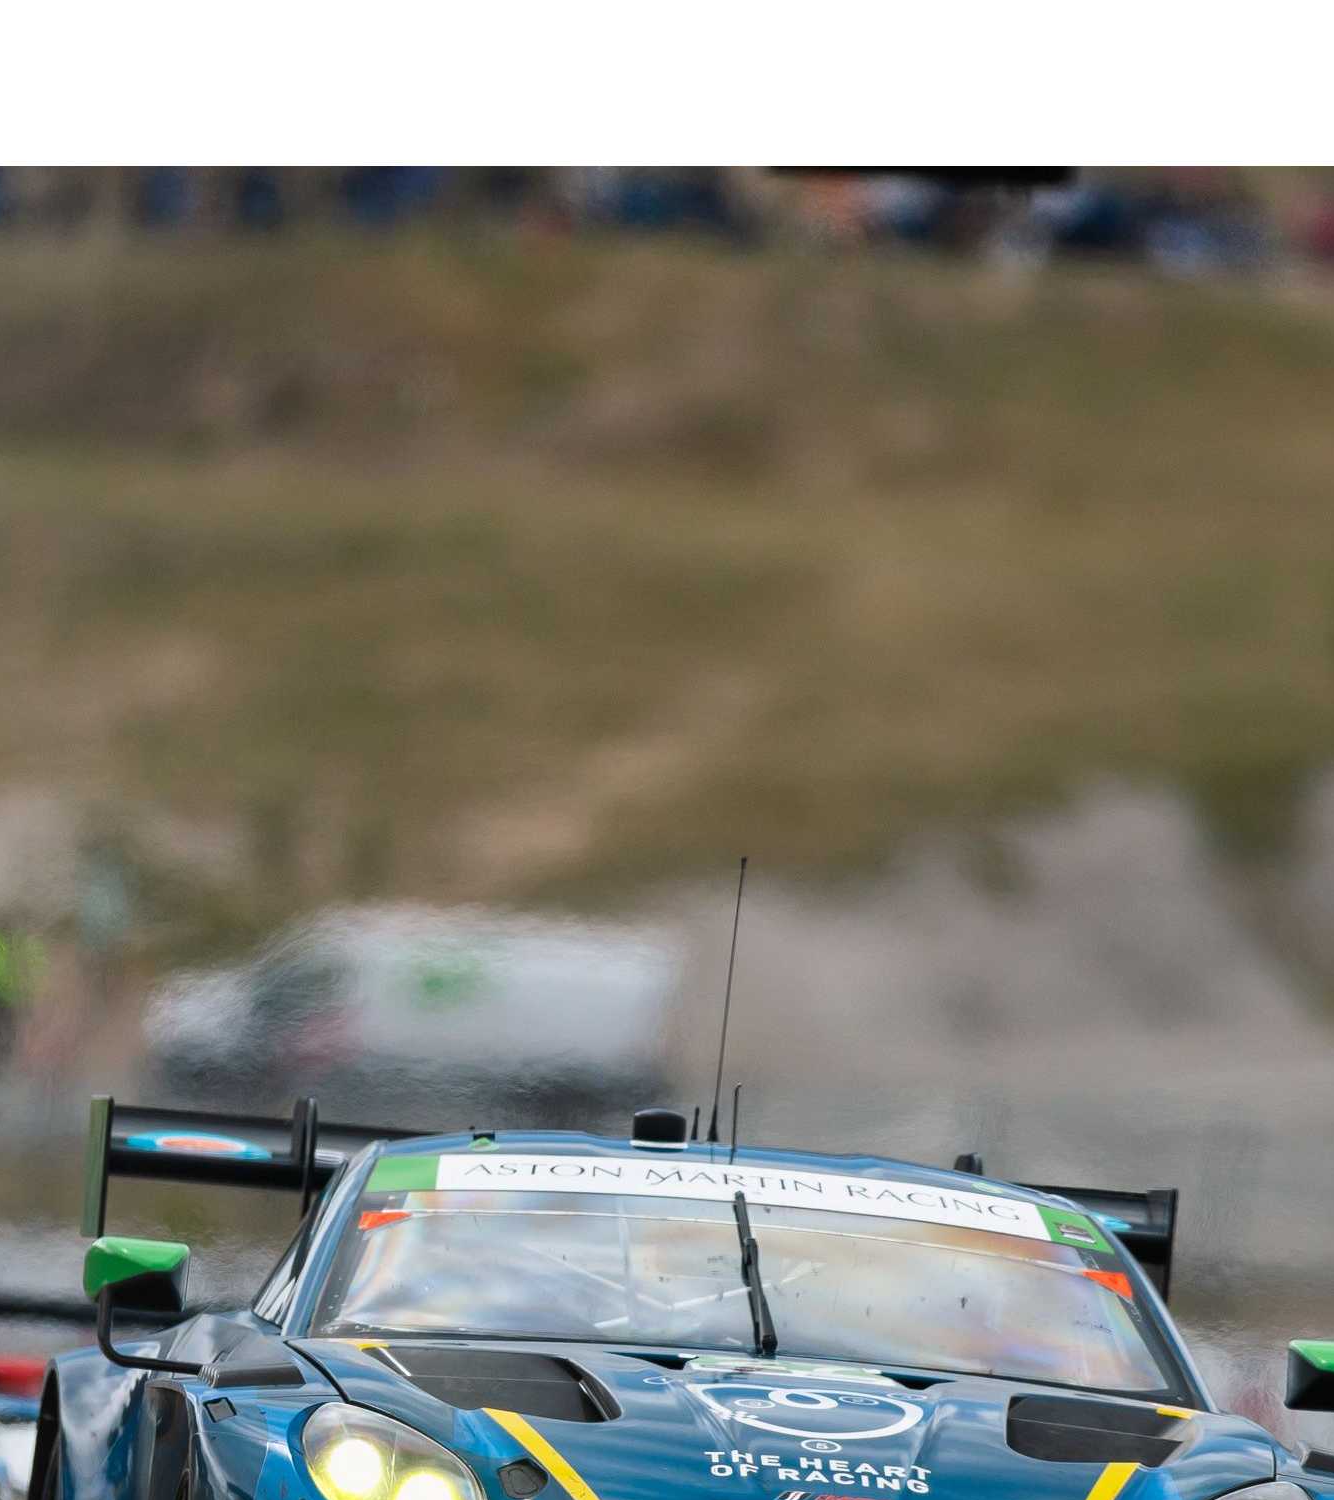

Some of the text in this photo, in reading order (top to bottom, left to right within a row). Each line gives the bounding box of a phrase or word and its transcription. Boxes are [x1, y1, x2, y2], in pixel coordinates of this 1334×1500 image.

[463, 1162, 1021, 1221] ASTON MARTIN RACING
[703, 1450, 932, 1481] THE HEART
[710, 1463, 930, 1494] OF RACING
